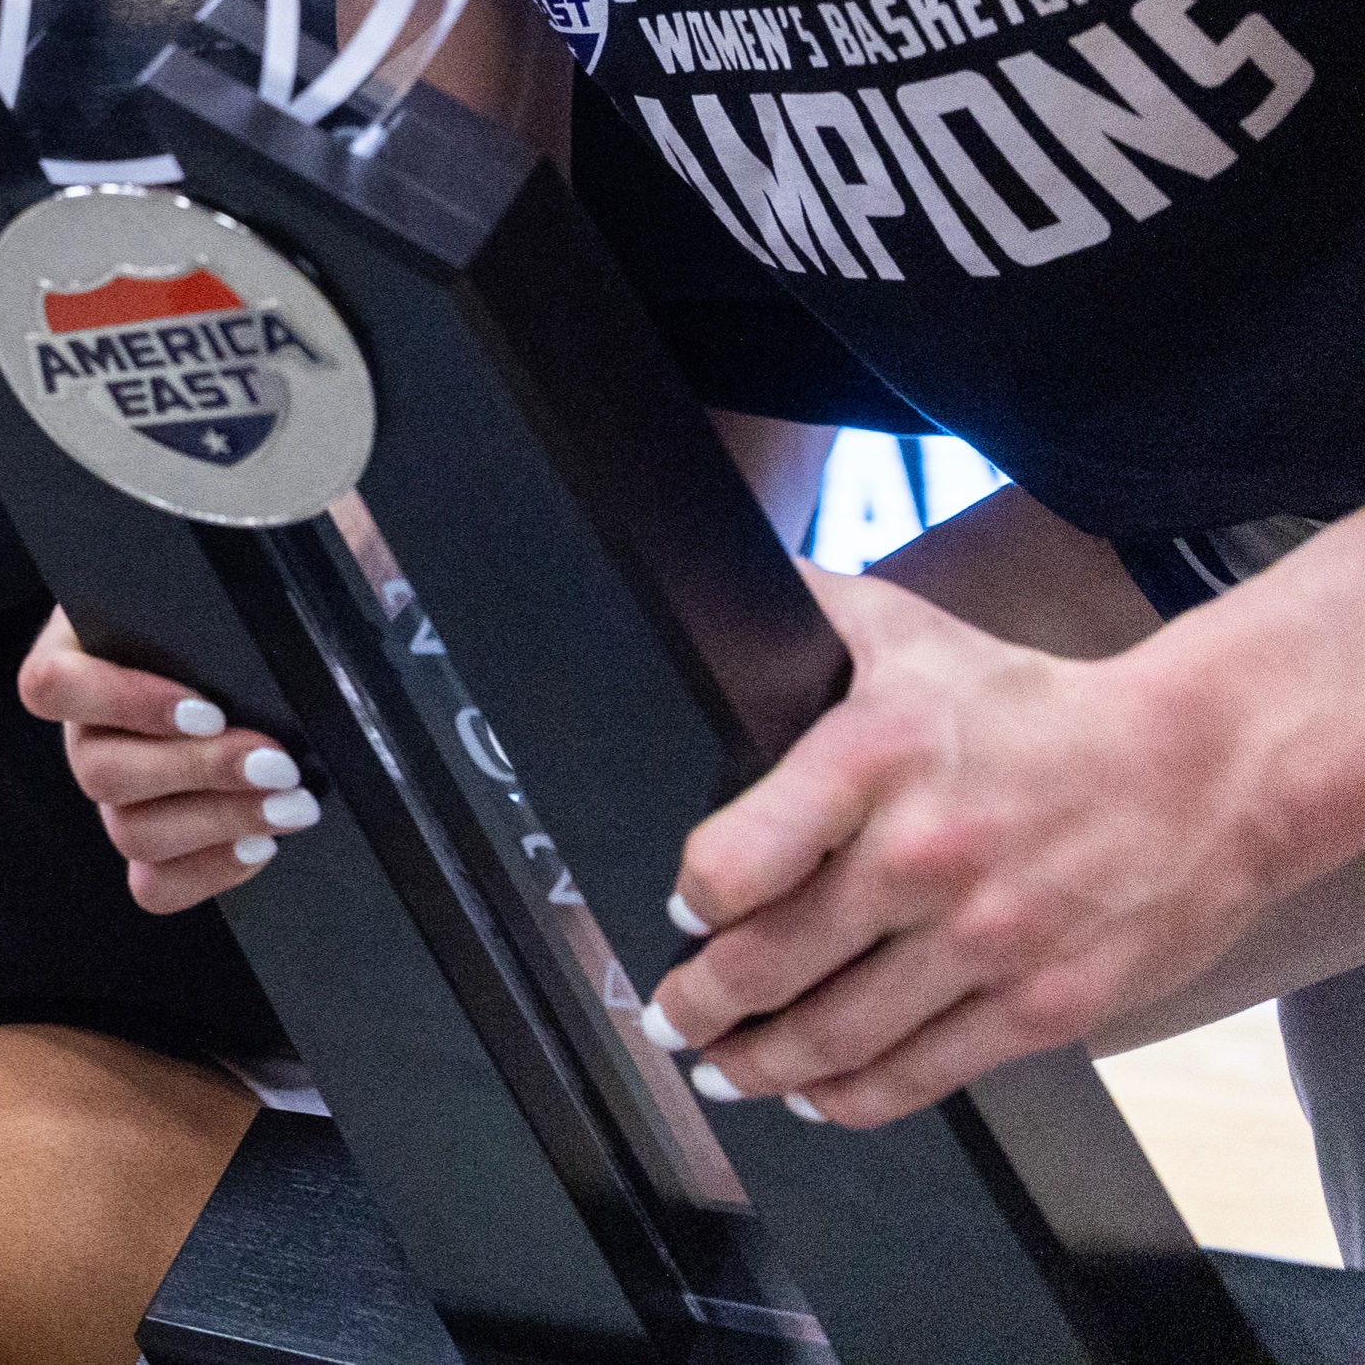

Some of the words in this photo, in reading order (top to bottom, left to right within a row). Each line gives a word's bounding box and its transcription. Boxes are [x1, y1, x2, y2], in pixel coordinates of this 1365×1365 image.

[638, 4, 828, 76] WOMEN'S
[35, 308, 339, 395] AMERICA
[106, 367, 264, 418] EAST
